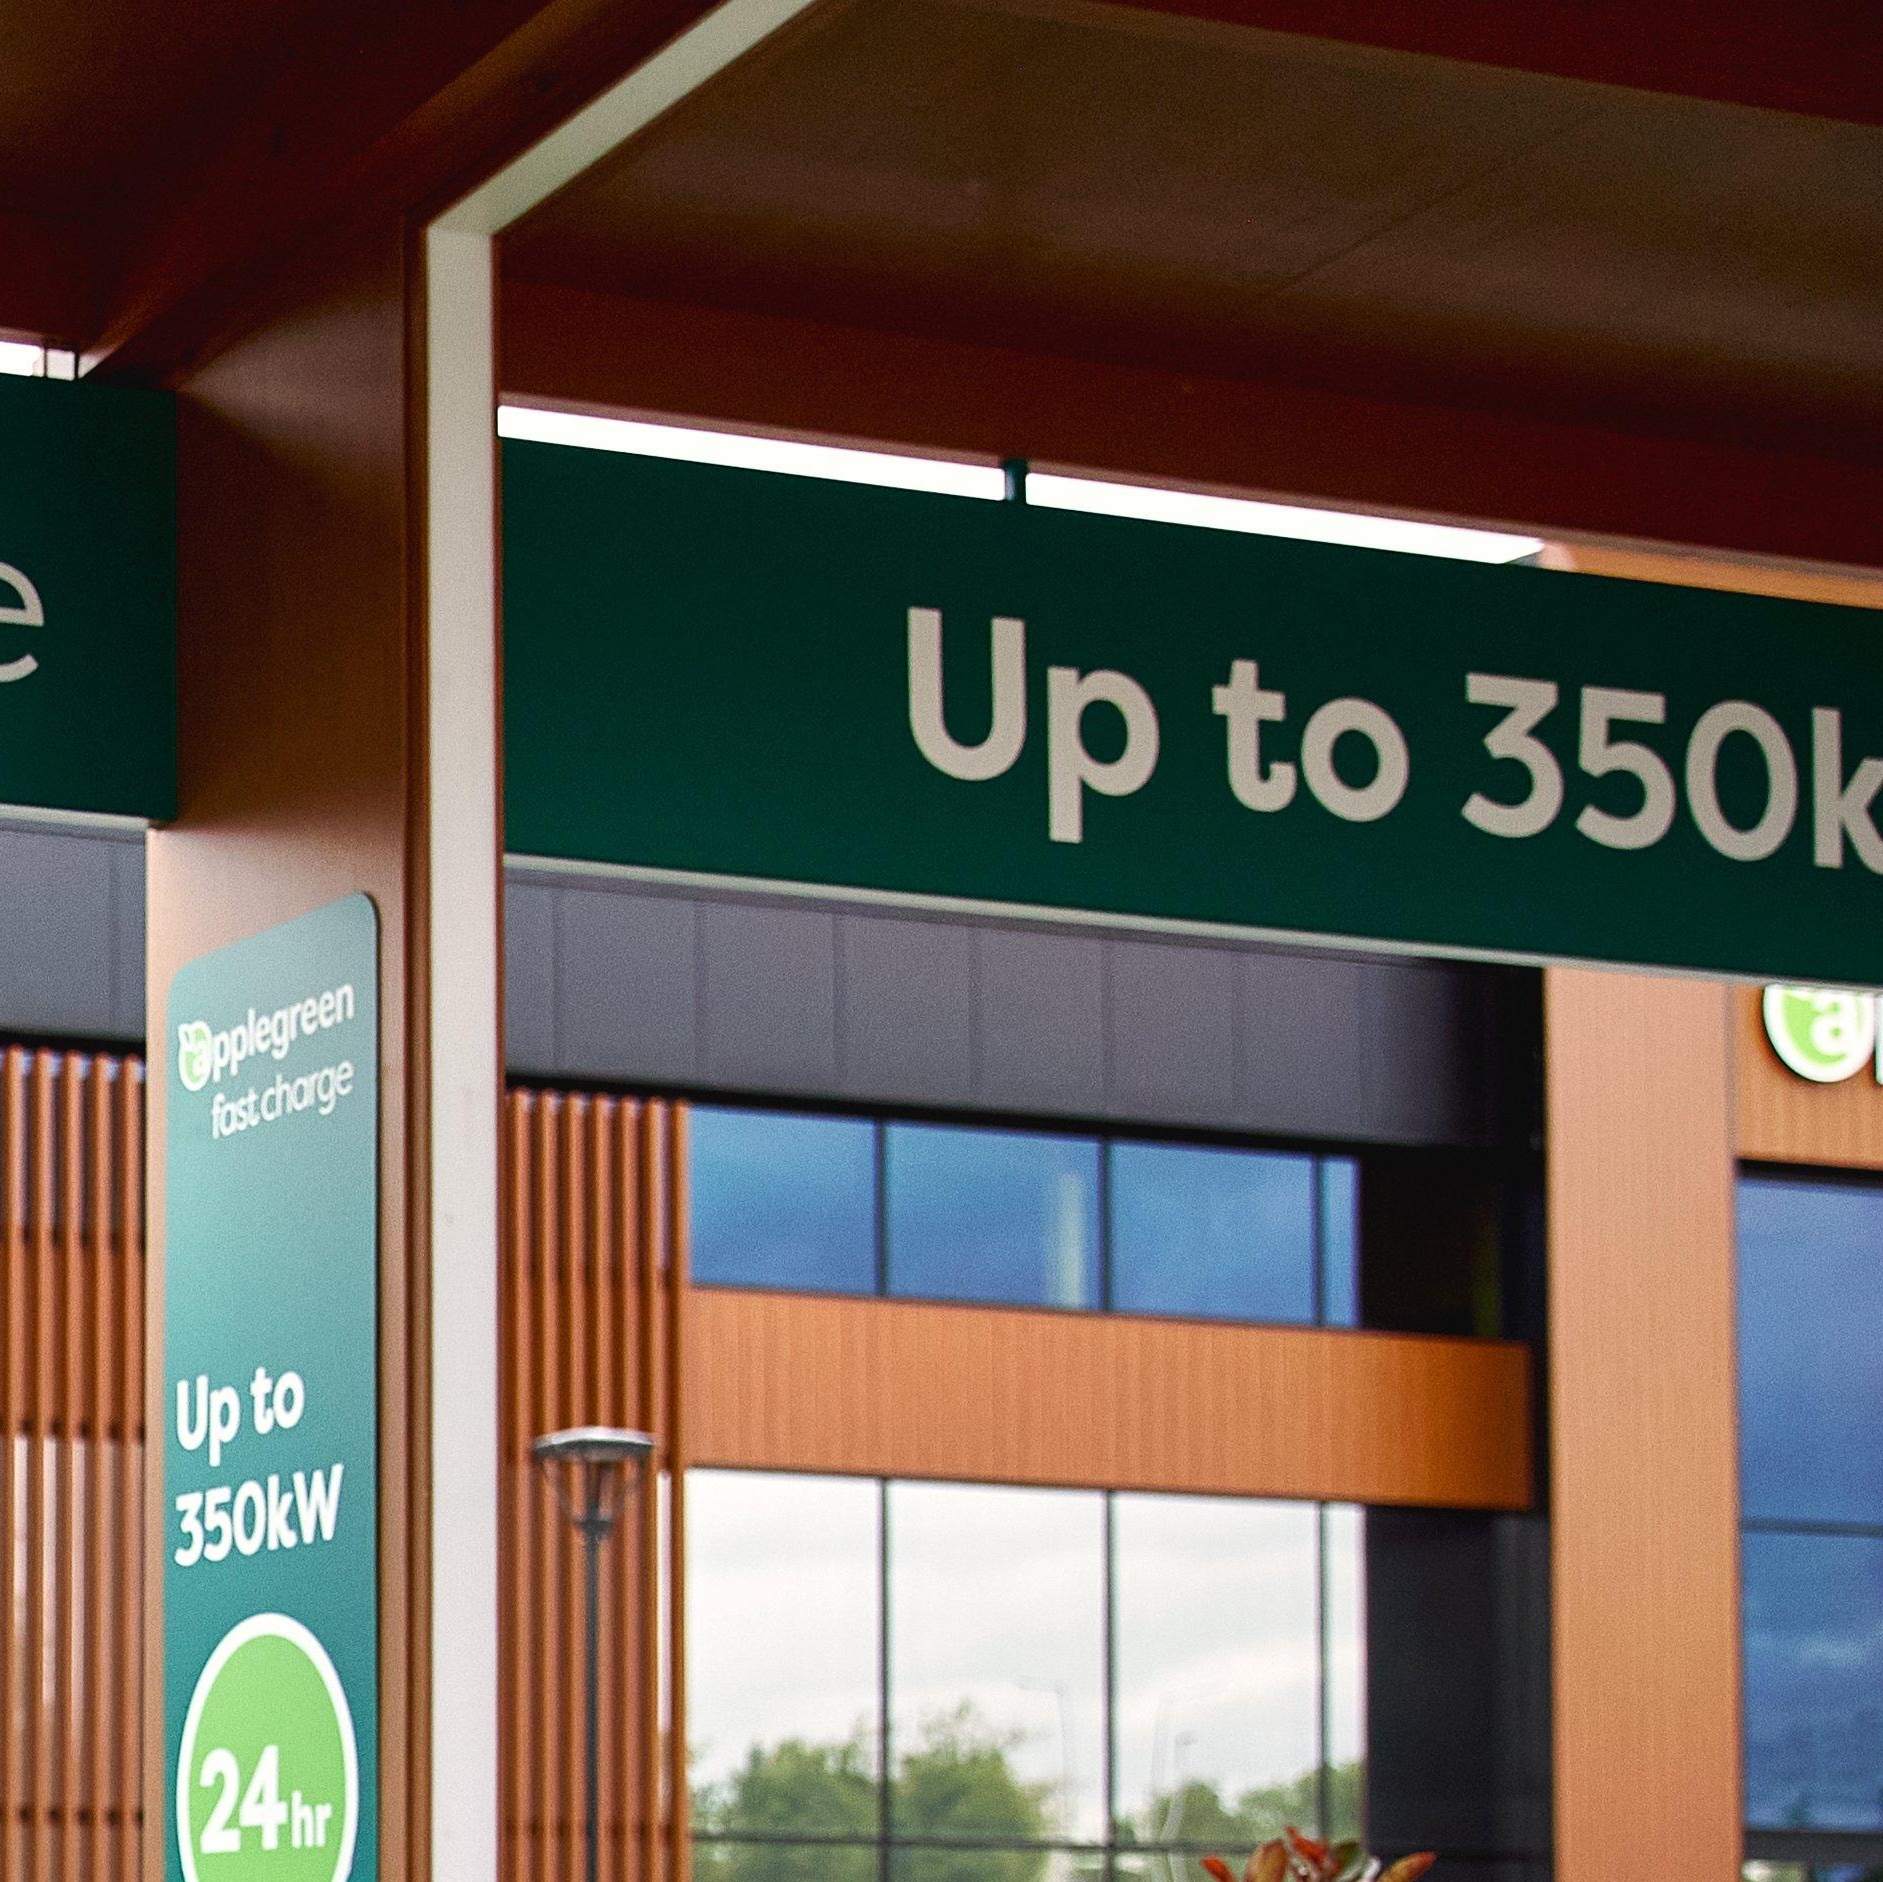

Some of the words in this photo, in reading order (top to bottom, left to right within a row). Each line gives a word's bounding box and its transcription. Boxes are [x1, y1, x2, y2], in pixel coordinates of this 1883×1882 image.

[906, 606, 1160, 843] Up
[1211, 659, 1410, 822] to
[1460, 672, 1883, 876] 350k
[177, 982, 356, 1092] applegreen
[211, 1083, 260, 1140] fast
[260, 1058, 355, 1117] charge
[175, 1373, 240, 1468] Up
[250, 1366, 305, 1437] to
[173, 1463, 344, 1568] 350kW
[199, 1744, 332, 1855] 24hr
